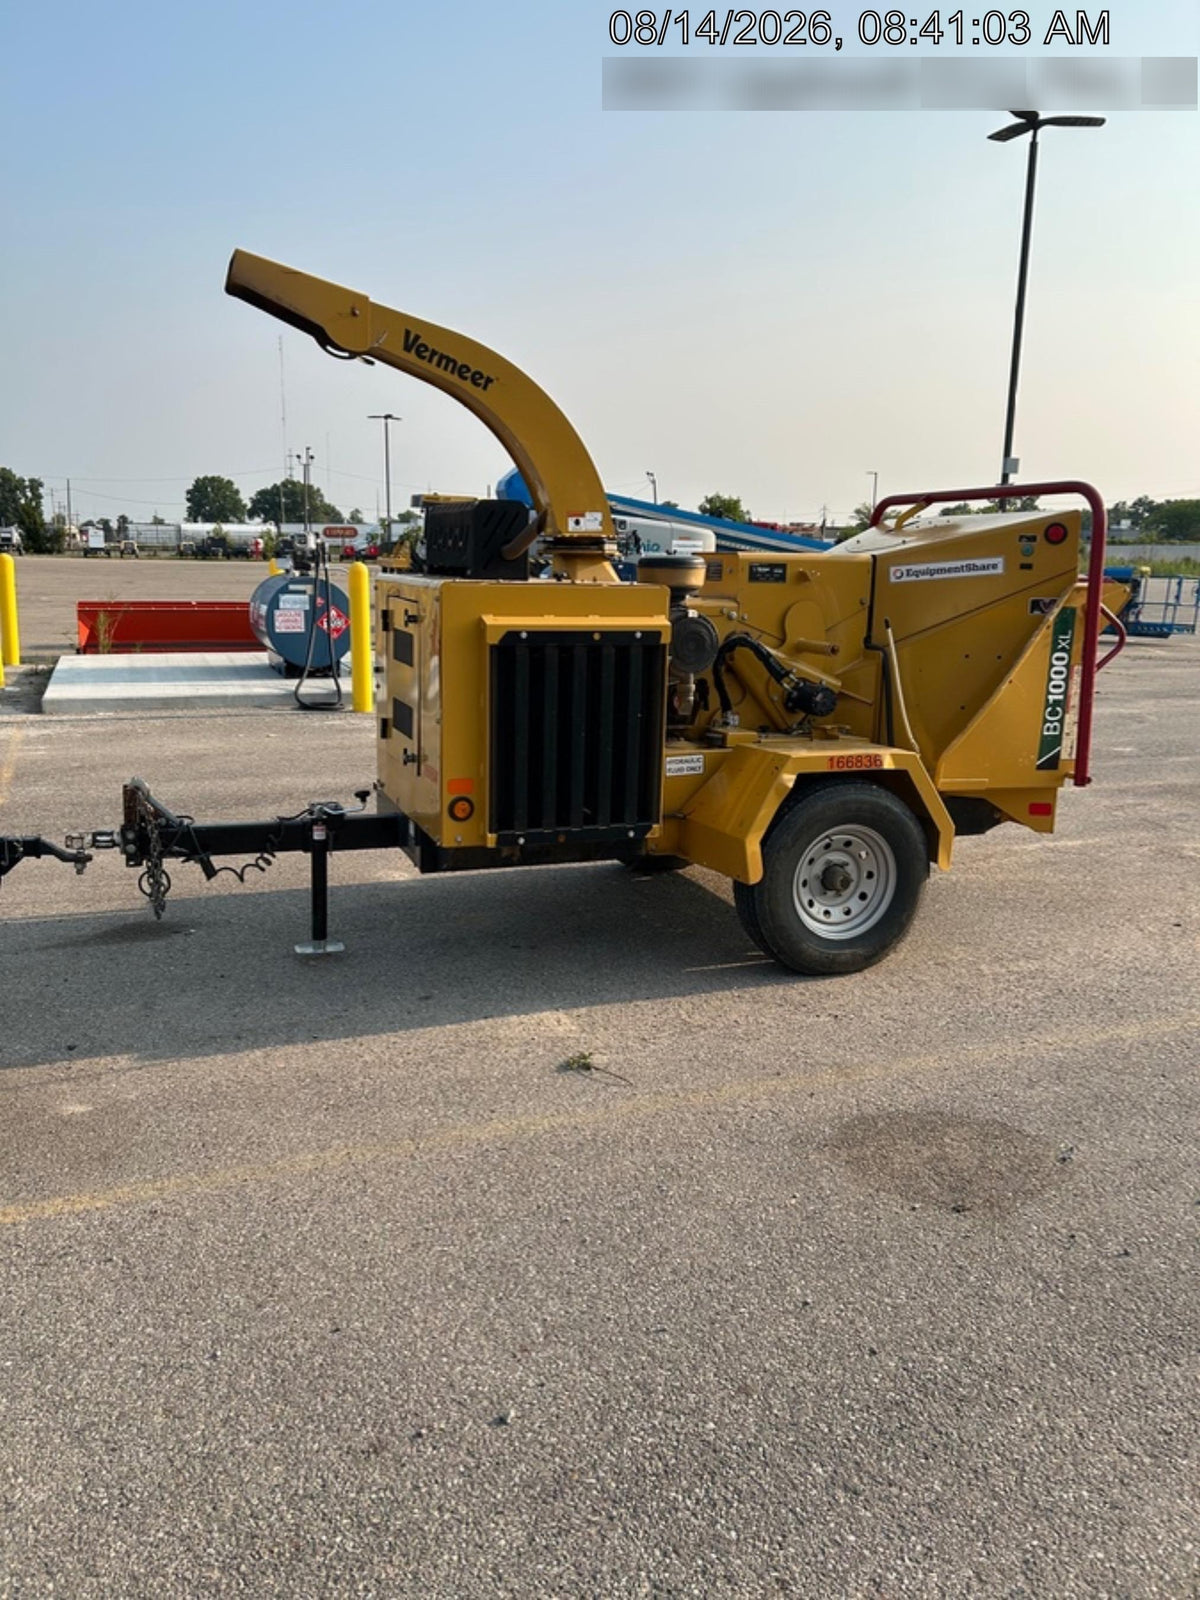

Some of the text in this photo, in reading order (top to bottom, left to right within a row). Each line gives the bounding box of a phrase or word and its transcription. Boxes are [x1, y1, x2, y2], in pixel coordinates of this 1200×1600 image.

[402, 328, 494, 391] Vermeer
[906, 562, 999, 579] EquipmentShare
[1043, 651, 1070, 735] BC1000
[1058, 629, 1072, 650] XL
[828, 753, 883, 769] 166836
